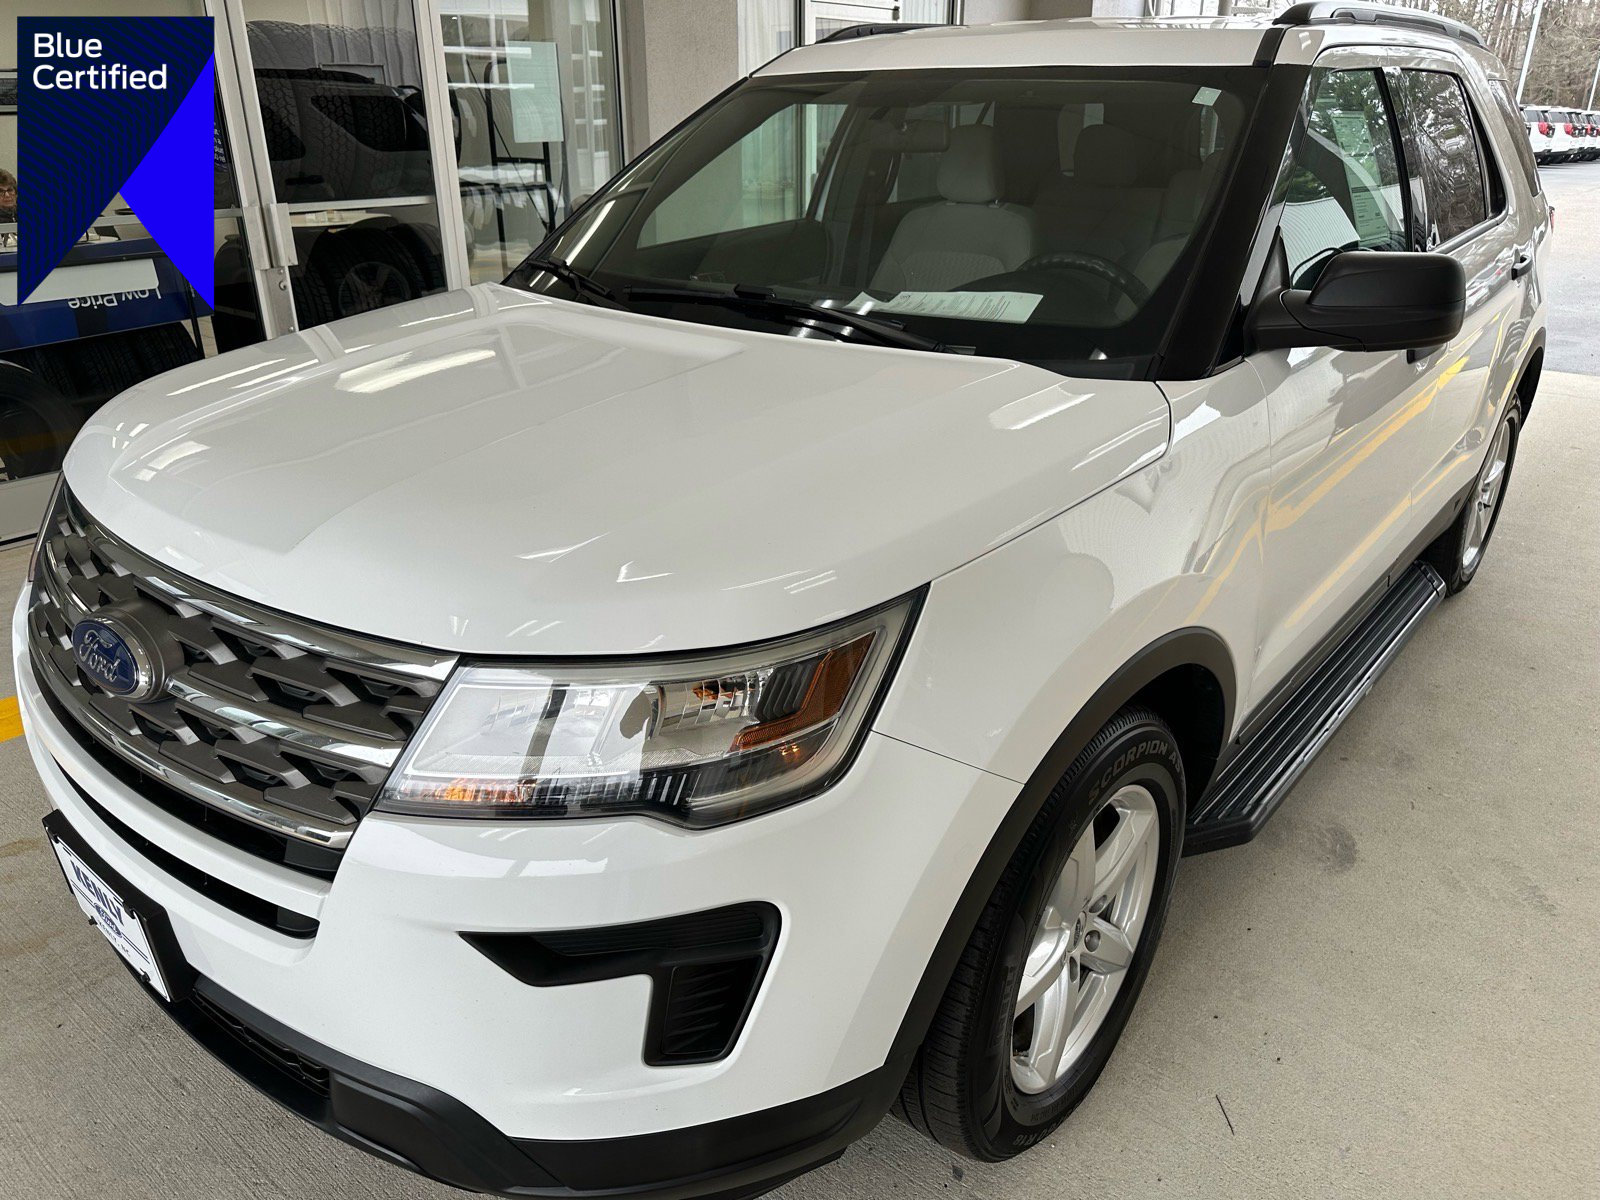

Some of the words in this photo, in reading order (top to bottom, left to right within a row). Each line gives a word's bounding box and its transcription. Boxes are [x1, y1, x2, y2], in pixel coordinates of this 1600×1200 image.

[67, 293, 119, 310] Price
[79, 629, 121, 683] Ford
[1088, 740, 1169, 806] SCORPION
[70, 859, 125, 928] KENLY
